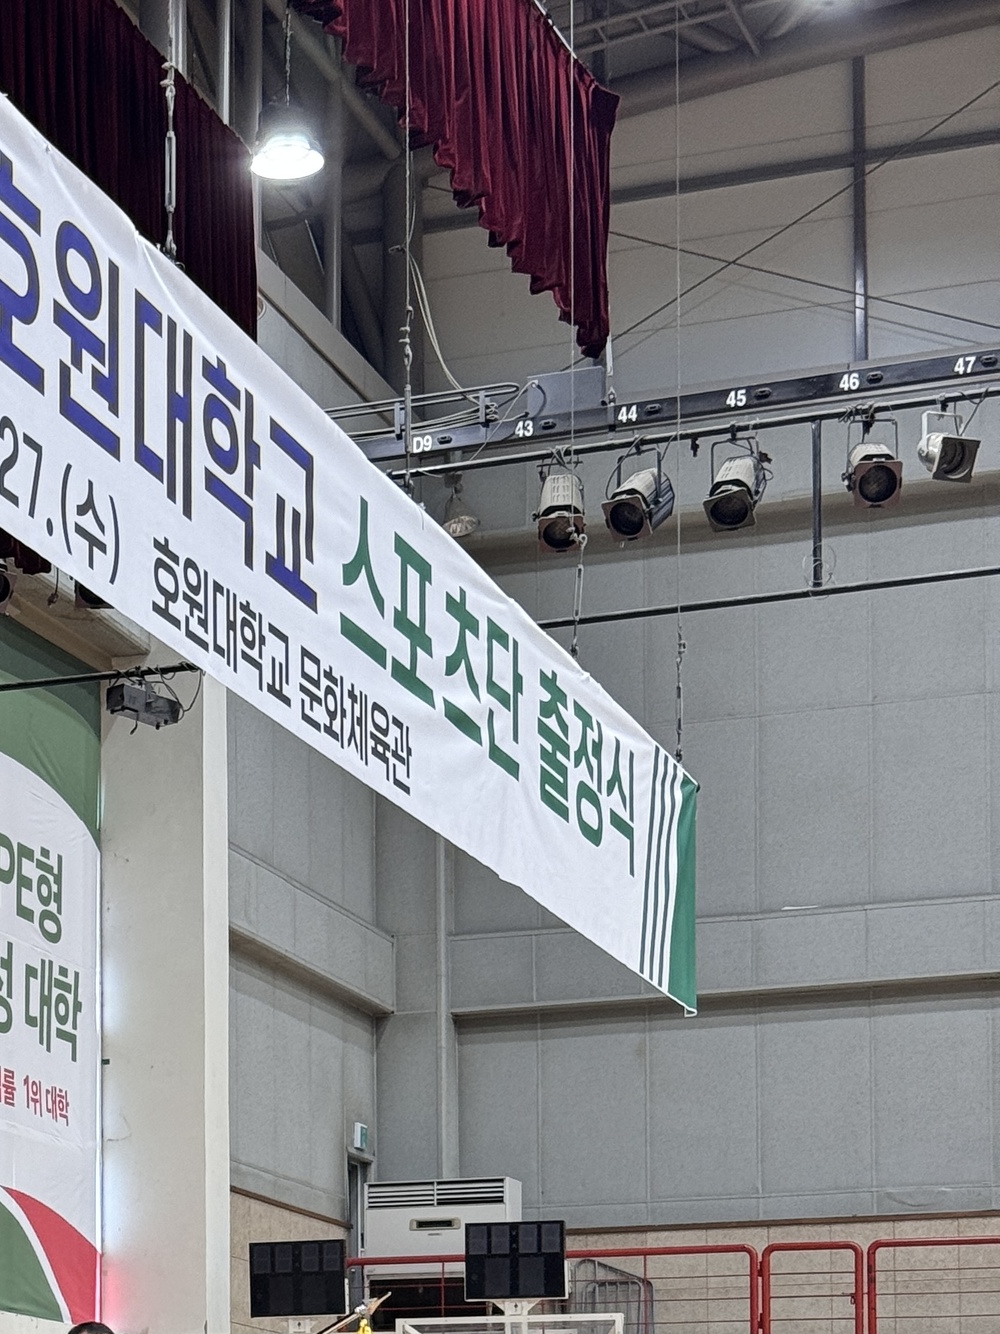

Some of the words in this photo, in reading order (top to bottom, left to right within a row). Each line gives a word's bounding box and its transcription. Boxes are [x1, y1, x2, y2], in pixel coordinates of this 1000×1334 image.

[953, 355, 977, 375] 47
[838, 372, 860, 392] 46
[725, 388, 747, 408] 45
[617, 405, 638, 423] 44
[514, 420, 534, 438] 43
[412, 435, 433, 454] D9
[151, 535, 291, 709] 호원대학교
[298, 644, 413, 797] 문화체육관
[340, 495, 524, 783] 스포츠단
[537, 668, 635, 878] 출정식
[24, 957, 83, 1063] 대학
